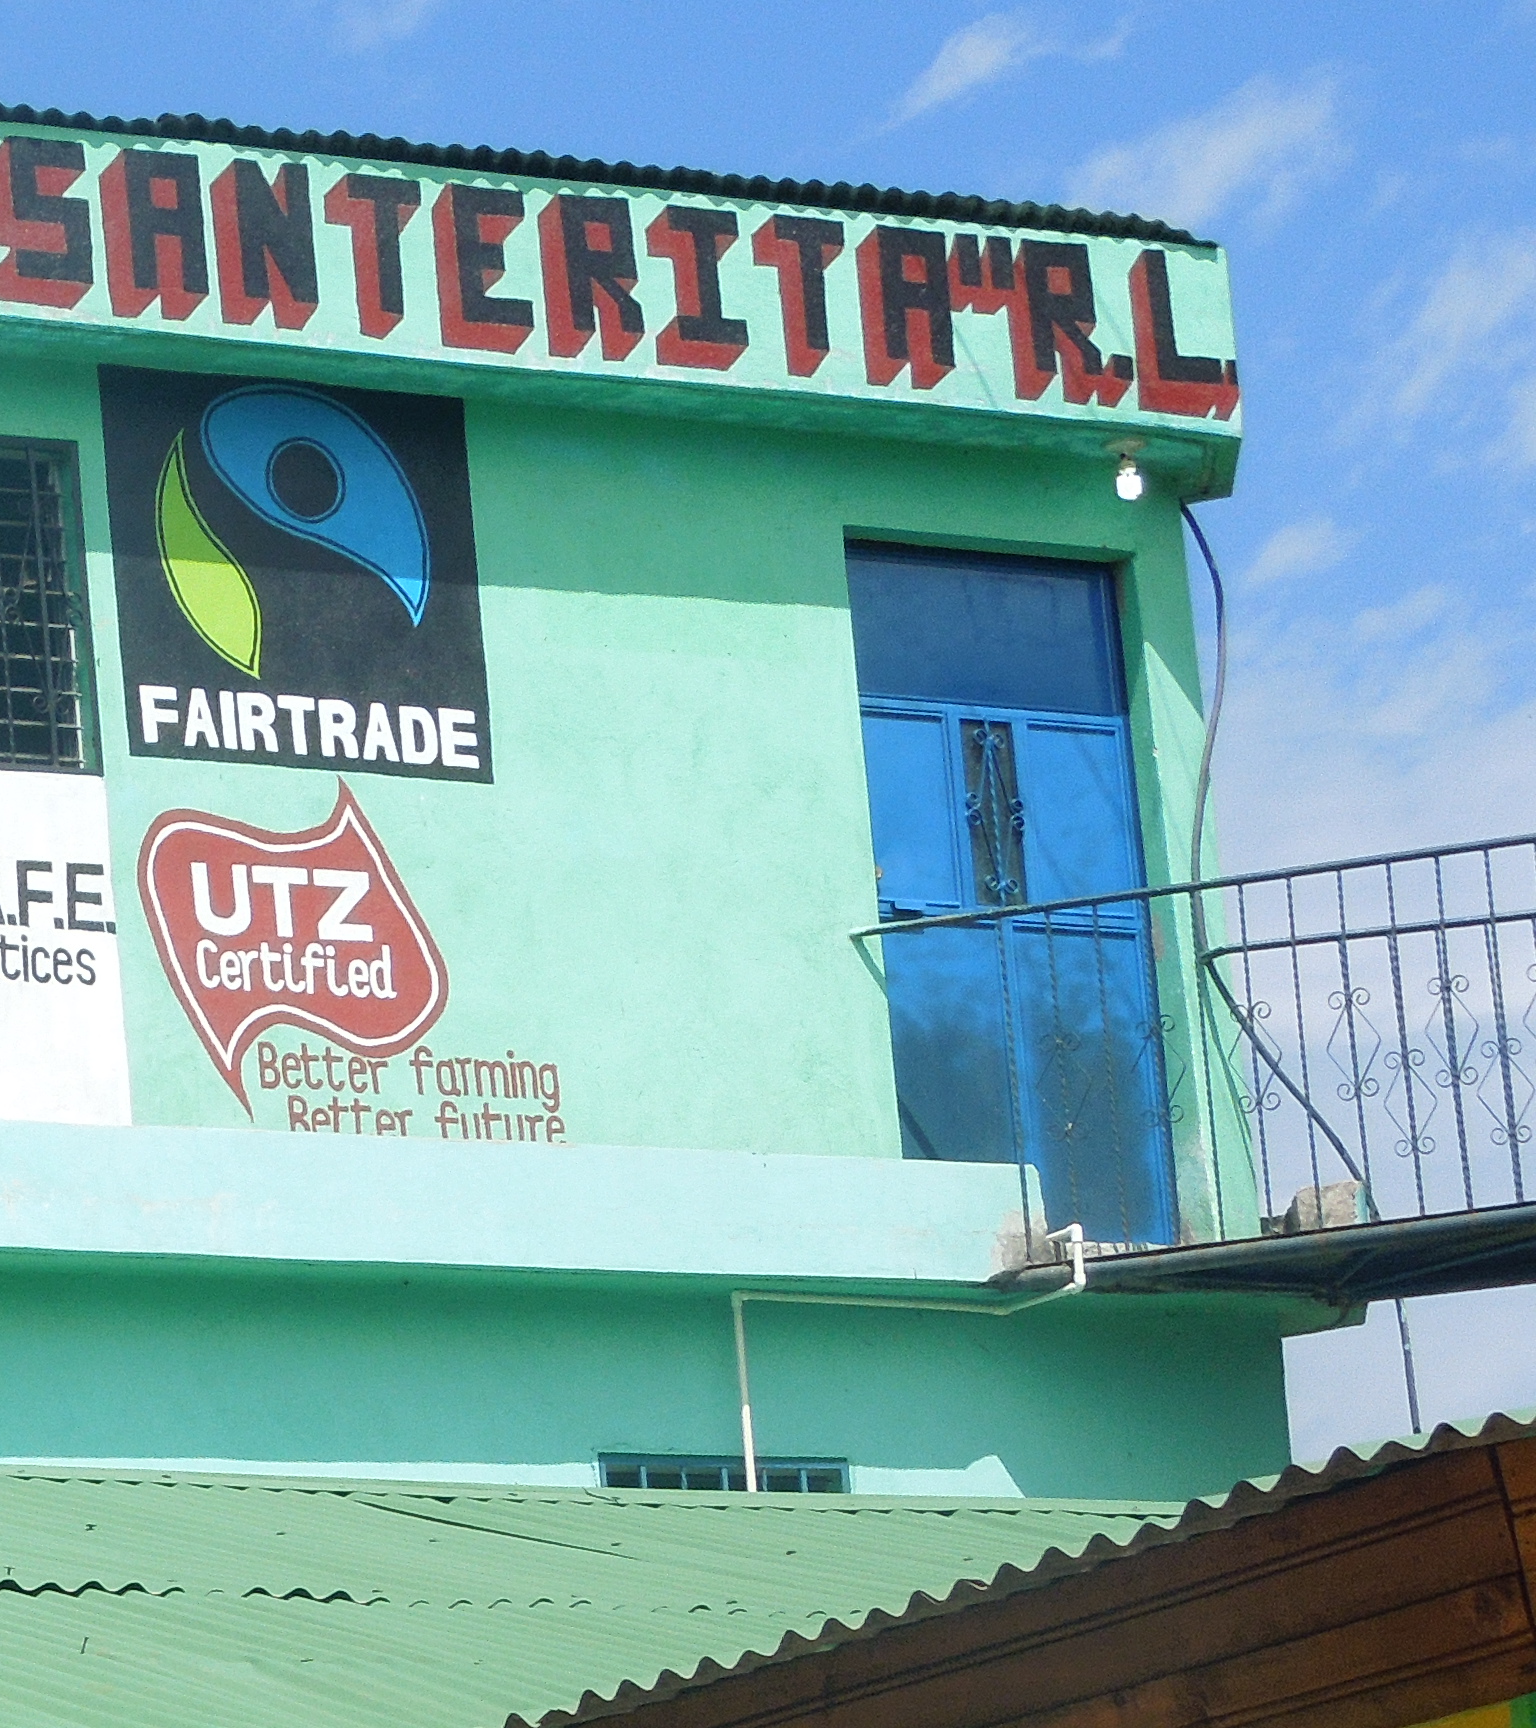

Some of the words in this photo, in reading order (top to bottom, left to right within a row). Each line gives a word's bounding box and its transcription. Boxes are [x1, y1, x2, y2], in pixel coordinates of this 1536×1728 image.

[138, 683, 481, 770] FAIRTRADE
[190, 861, 375, 943] UTZ
[195, 938, 398, 1000] Certified
[257, 1041, 390, 1095] Better
[409, 1044, 562, 1113] farming
[287, 1094, 414, 1137] Better
